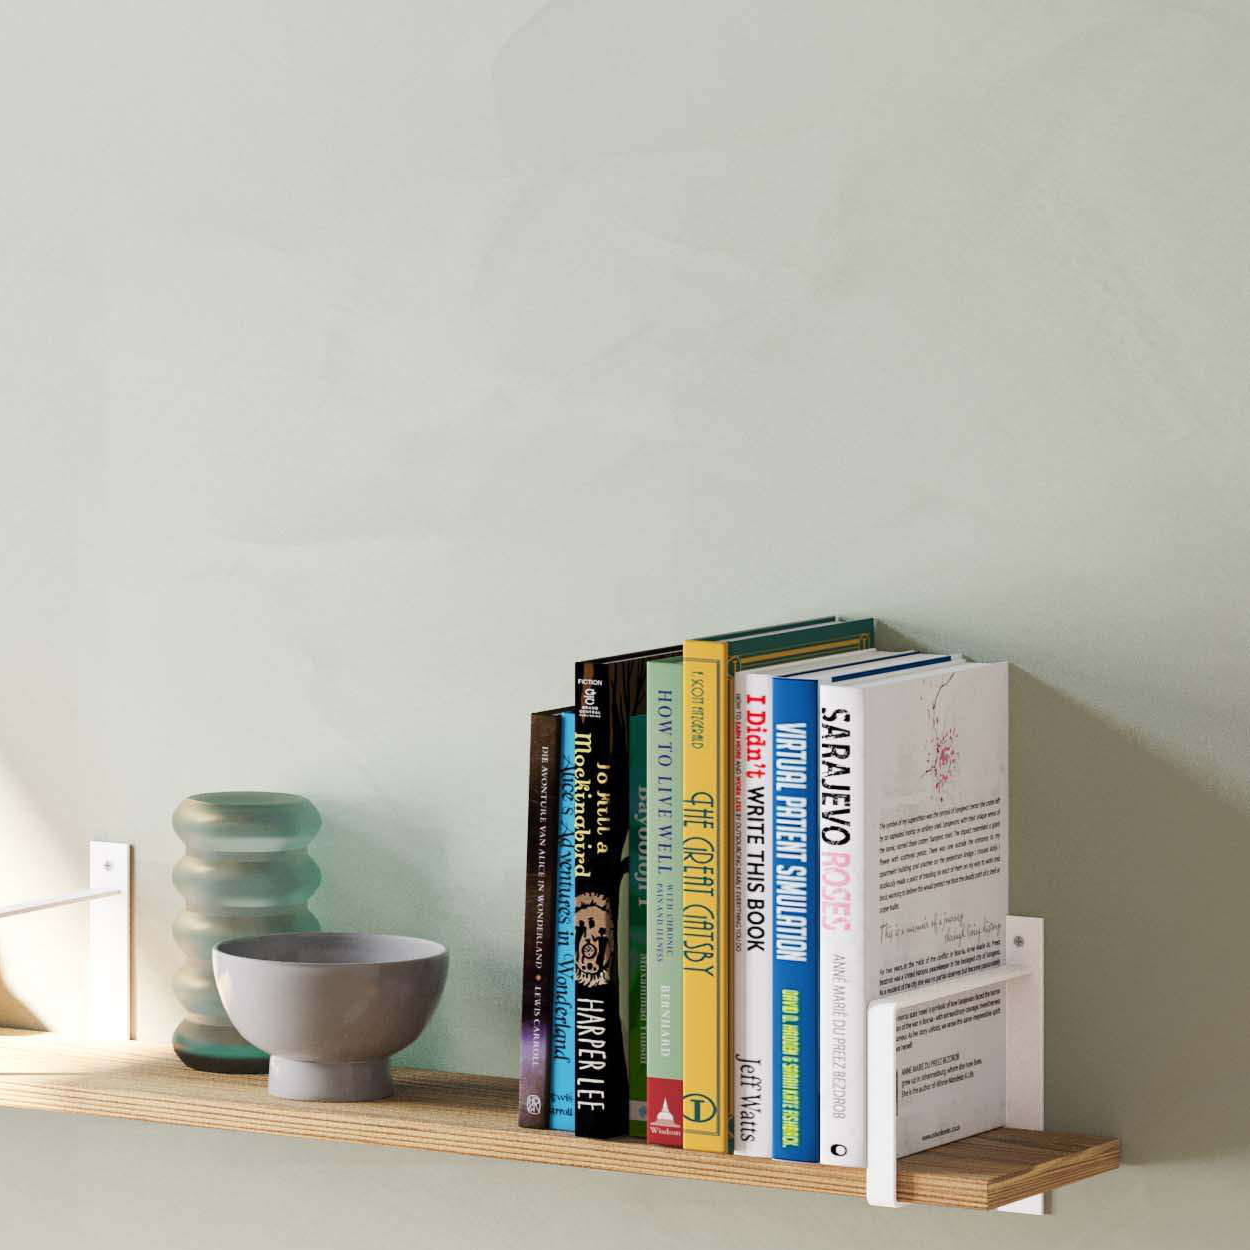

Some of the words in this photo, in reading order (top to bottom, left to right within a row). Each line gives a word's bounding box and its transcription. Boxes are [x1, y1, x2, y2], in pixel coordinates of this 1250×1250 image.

[657, 690, 672, 736] HOW
[747, 694, 766, 704] I
[541, 746, 549, 763] DIE
[657, 741, 672, 767] TO
[747, 710, 768, 778] Didn't
[776, 722, 807, 791] VIRTUAL
[540, 765, 549, 823] AVONTURE
[657, 775, 672, 819] LIVE
[821, 708, 851, 846] SARAJEVO
[574, 731, 592, 878] Mockingbird
[683, 791, 715, 829] THE
[747, 786, 764, 845] WRITE
[539, 825, 547, 847] VAN
[596, 841, 611, 855] a
[657, 824, 672, 875] WELL
[776, 795, 807, 862] PATIENT
[537, 880, 545, 892] IN
[538, 849, 546, 879] ALICE
[683, 837, 715, 897] GREAT
[747, 850, 764, 893] THIS
[776, 864, 807, 962] SIMULATION
[821, 850, 851, 931] ROSES
[535, 893, 545, 969] WONDERLAND
[557, 931, 574, 947] in
[656, 927, 664, 963] ILLNESS
[683, 904, 715, 977] GATSBY
[747, 899, 764, 952] BOOK
[533, 986, 542, 1016] LEWIS
[553, 953, 575, 1063] Wonderland
[660, 985, 671, 1057] BERNHARD
[532, 1018, 540, 1068] CARROLL
[576, 998, 607, 1071] HARPER
[832, 1019, 846, 1034] DU
[735, 1054, 761, 1091] Jeff
[832, 1038, 846, 1068] PREEZ
[576, 1077, 605, 1111] LEE
[832, 1071, 846, 1119] BEZDROB
[650, 1127, 681, 1136] Wisdom
[740, 1095, 762, 1142] Watts
